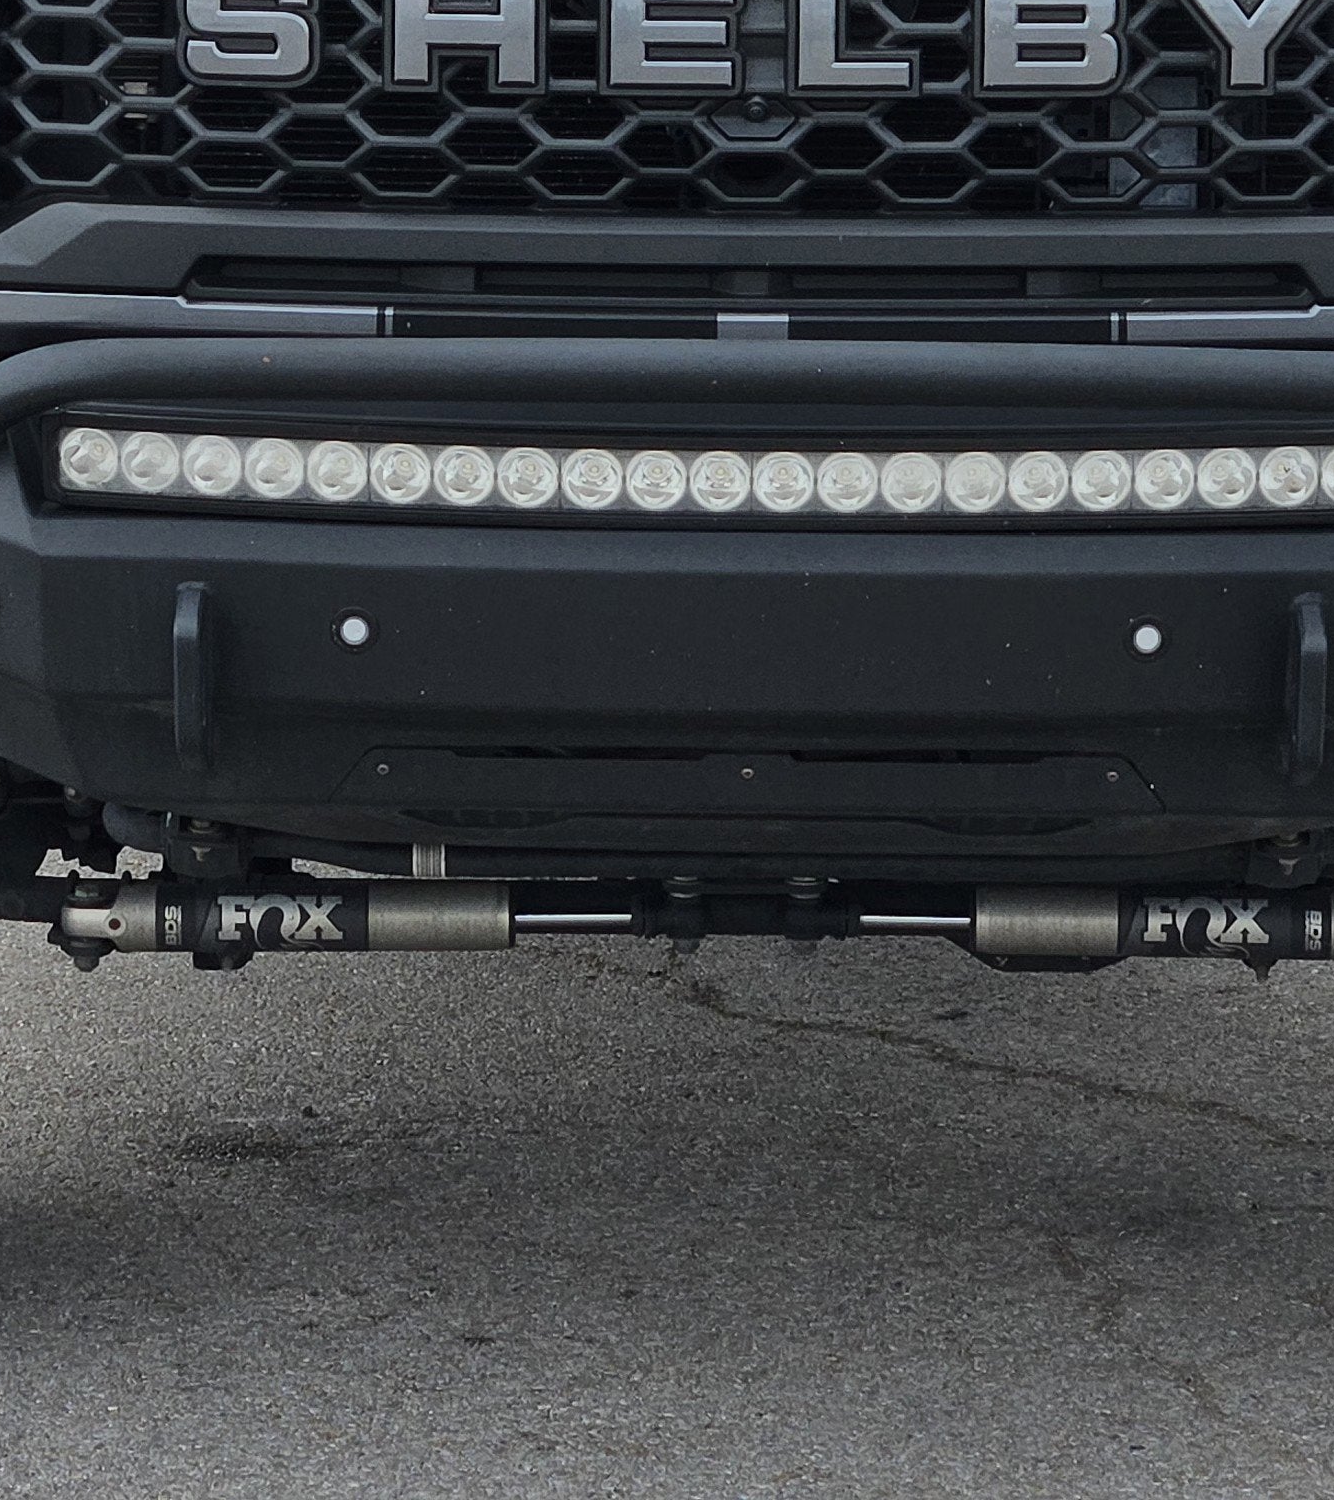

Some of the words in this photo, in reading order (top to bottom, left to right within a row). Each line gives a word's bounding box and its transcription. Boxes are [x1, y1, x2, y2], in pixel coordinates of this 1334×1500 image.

[164, 905, 177, 946] BDS
[217, 894, 343, 949] FOX
[1143, 897, 1269, 952] FOX
[1310, 910, 1323, 951] BDS
